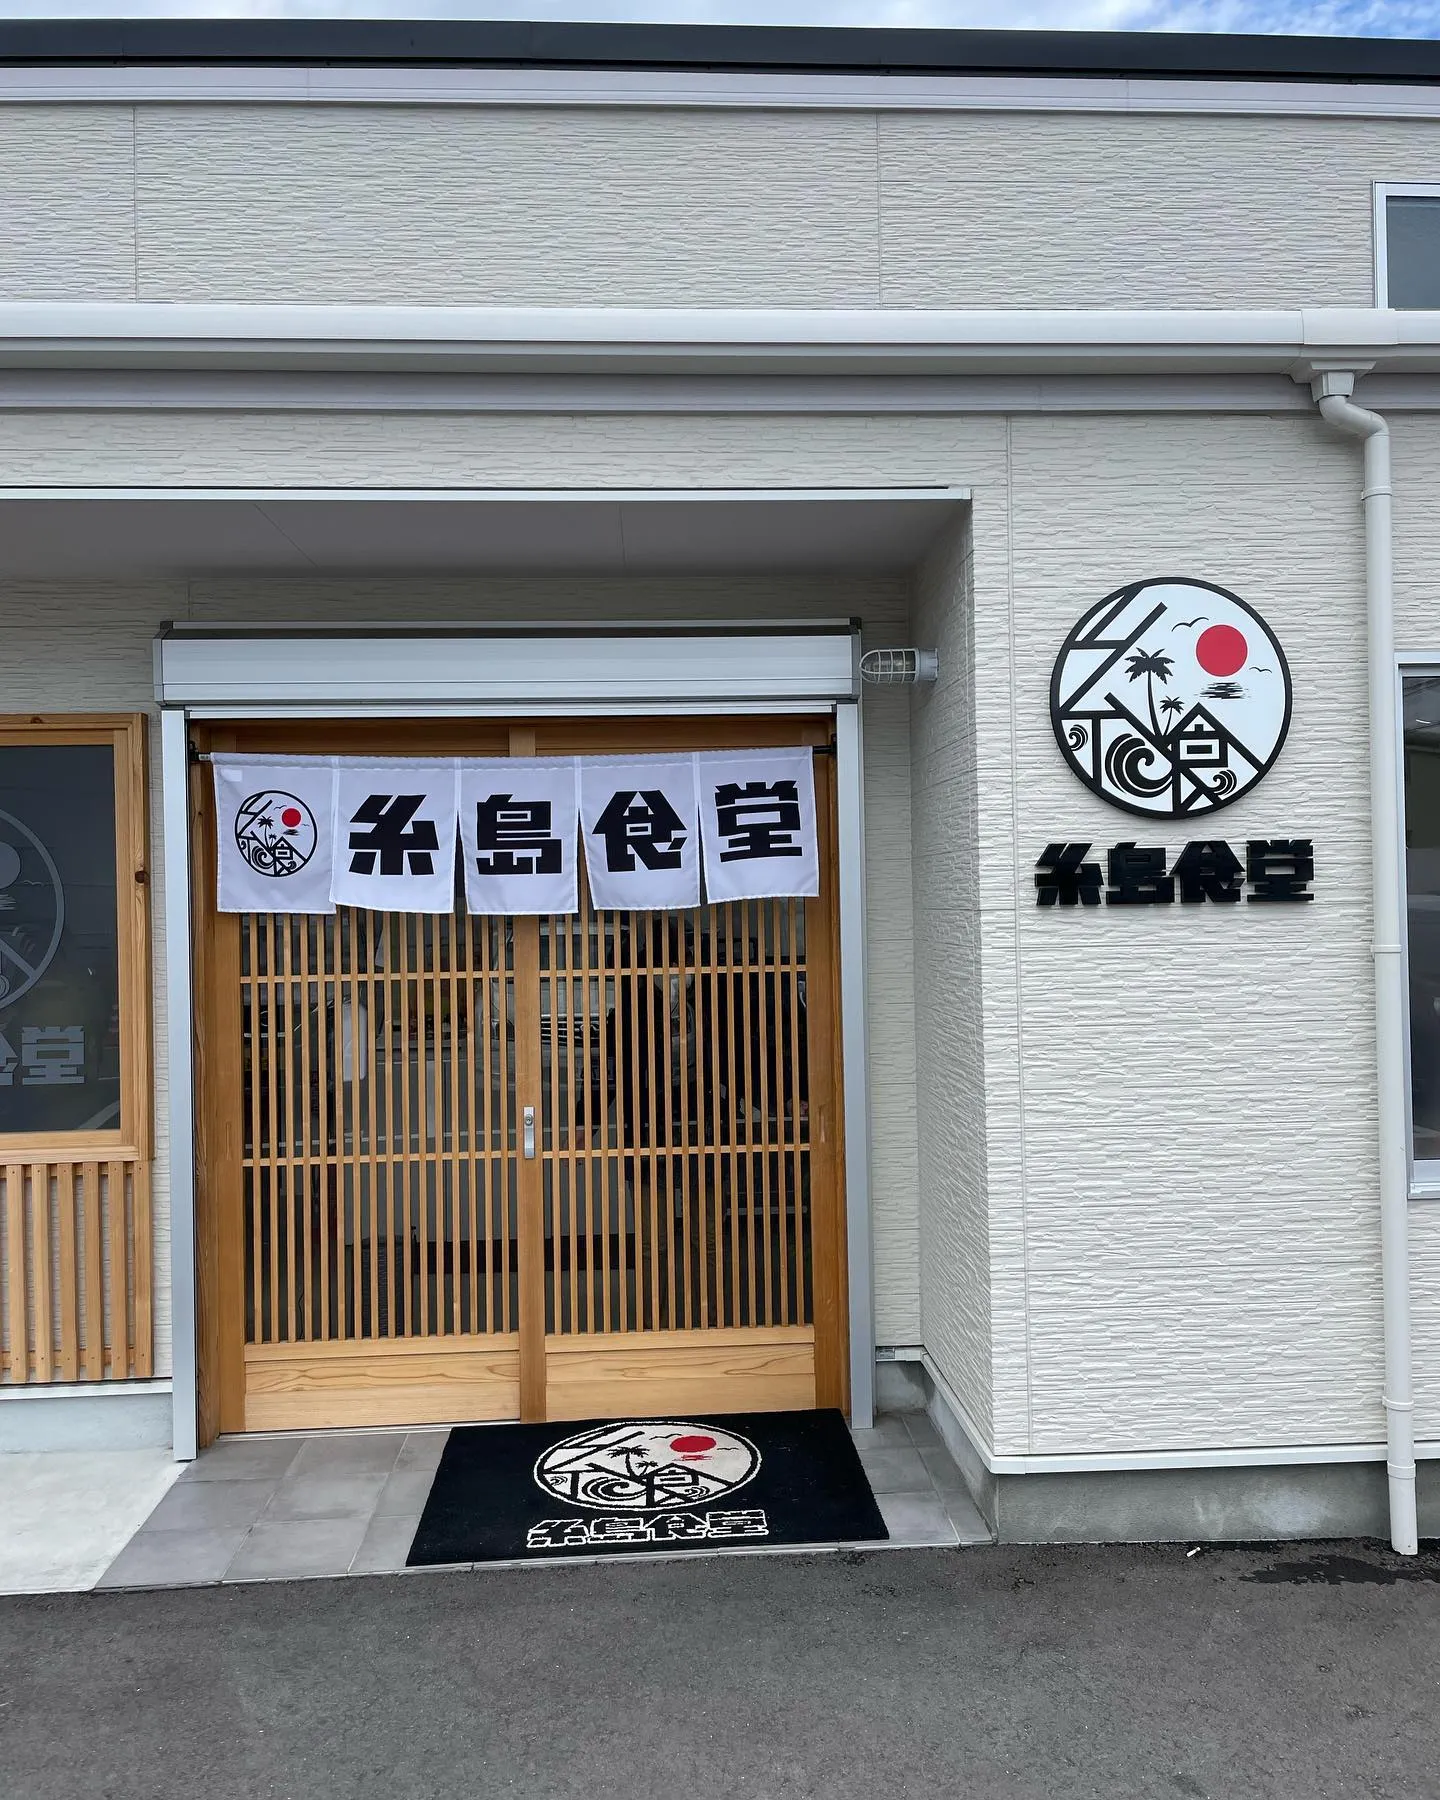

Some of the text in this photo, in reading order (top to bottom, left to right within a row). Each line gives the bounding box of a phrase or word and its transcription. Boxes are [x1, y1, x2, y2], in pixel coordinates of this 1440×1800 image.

[348, 780, 803, 876] 糸島食堂
[1034, 839, 1315, 906] 糸島食堂
[0, 1022, 84, 1086] 堂
[526, 1509, 769, 1548] 糸島食堂
